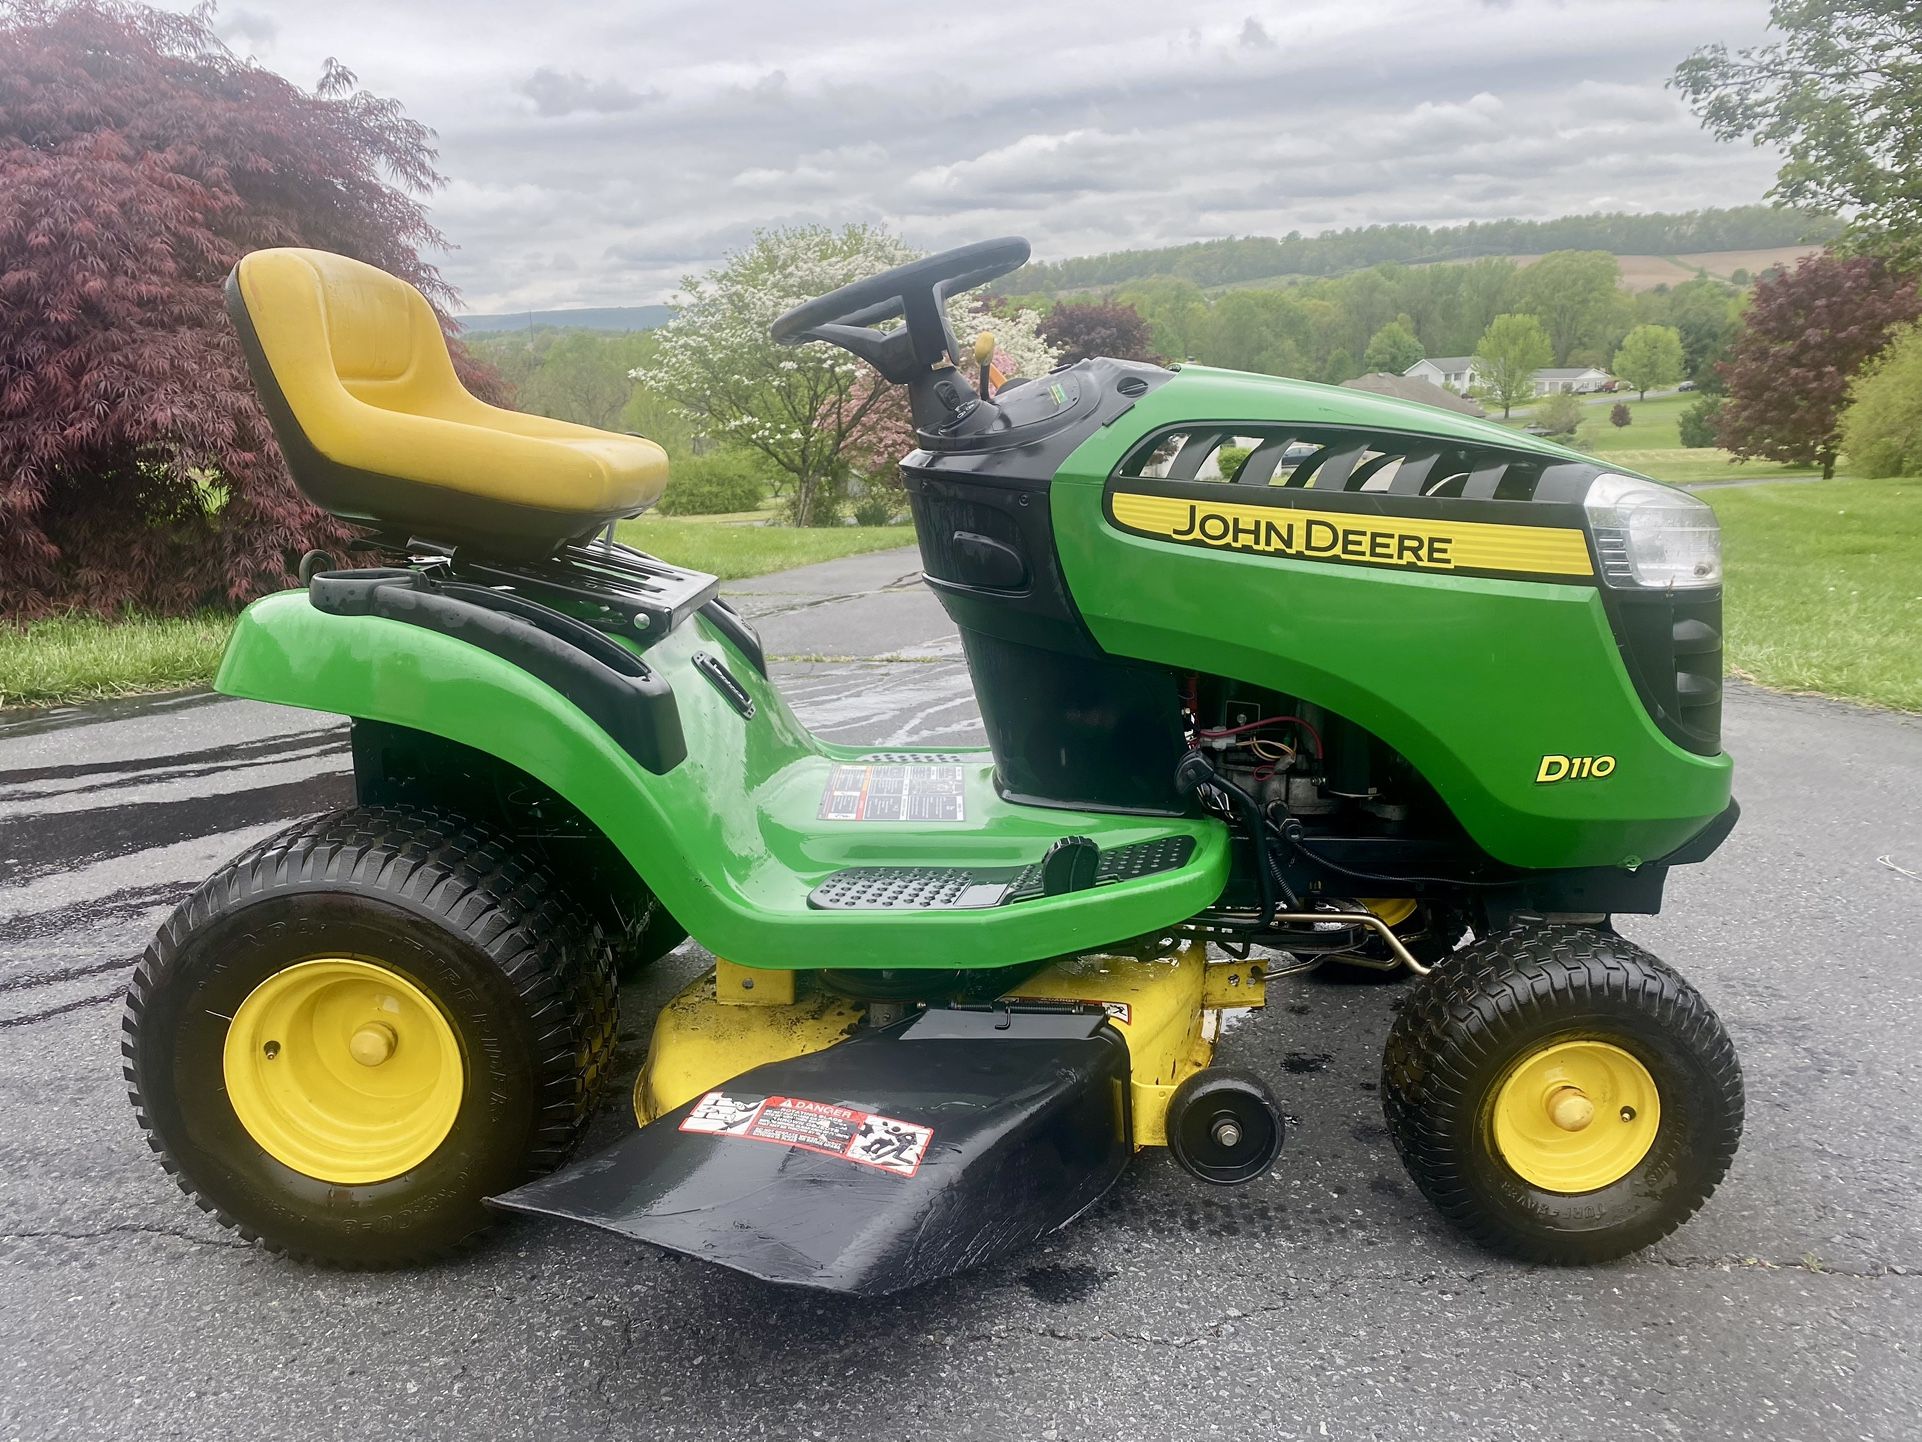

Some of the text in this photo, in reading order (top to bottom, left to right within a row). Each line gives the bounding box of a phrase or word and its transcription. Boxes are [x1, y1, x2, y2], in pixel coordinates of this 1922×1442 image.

[1172, 504, 1453, 564] JOHN DEERE
[1536, 754, 1616, 782] D110
[795, 1101, 851, 1118] DANGER
